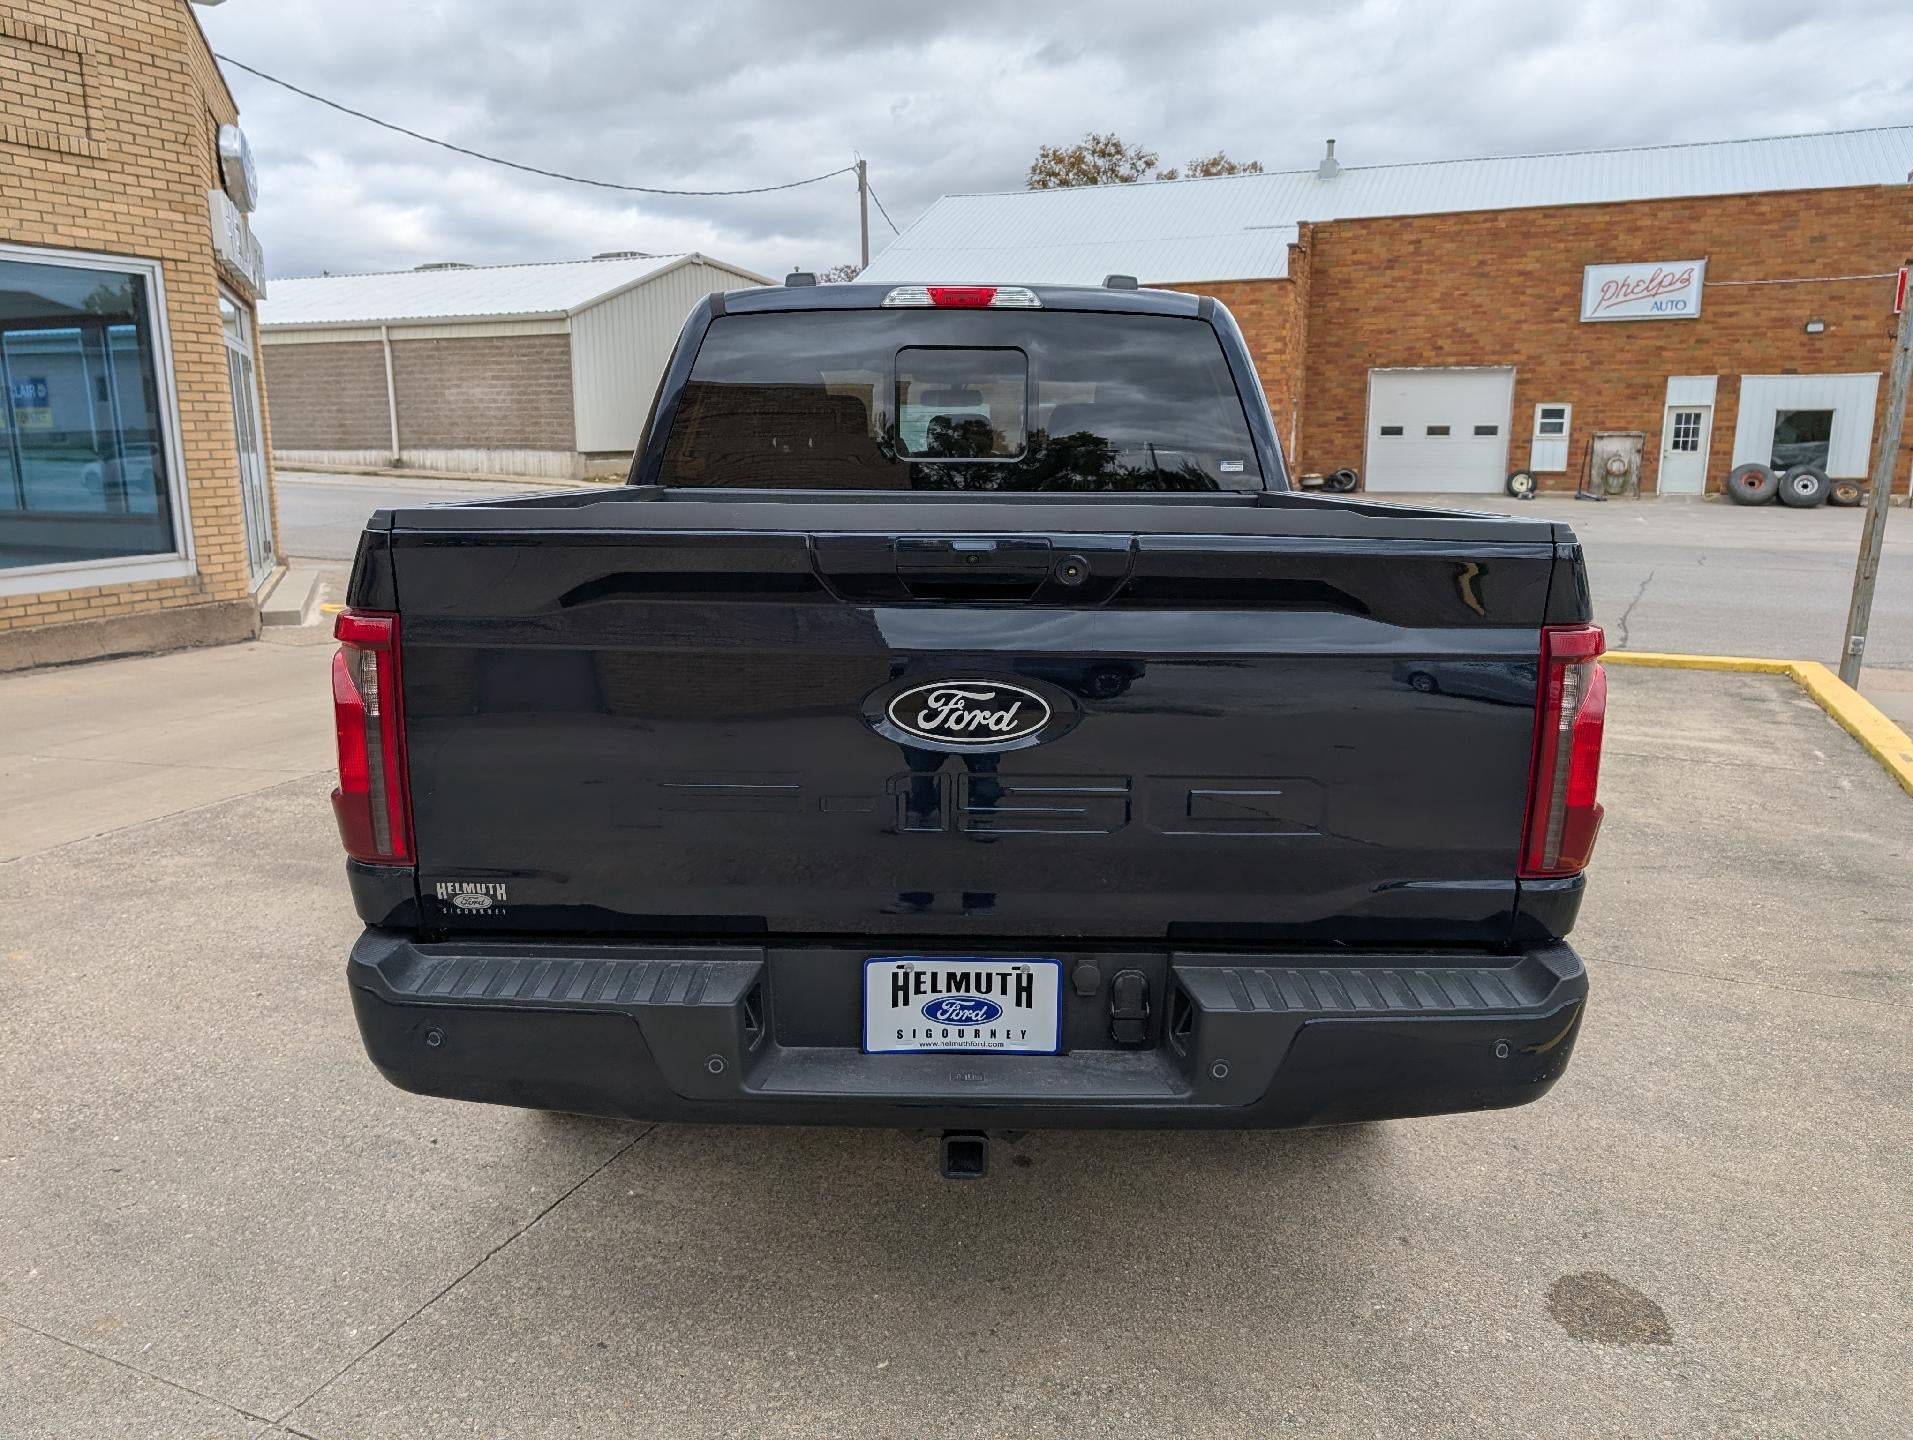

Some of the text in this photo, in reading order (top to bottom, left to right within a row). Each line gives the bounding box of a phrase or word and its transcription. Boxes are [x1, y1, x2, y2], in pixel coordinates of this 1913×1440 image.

[1592, 267, 1695, 316] Phelps
[1650, 300, 1687, 312] AUTO
[917, 689, 1021, 731] Ford
[436, 882, 507, 901] HELMUTH
[460, 896, 486, 906] Ford
[891, 971, 1034, 1010] HELMUTH
[936, 1000, 987, 1022] Ford
[896, 1028, 1027, 1040] SIGOURNEY
[919, 1040, 1005, 1049] www.helmuthford.com
